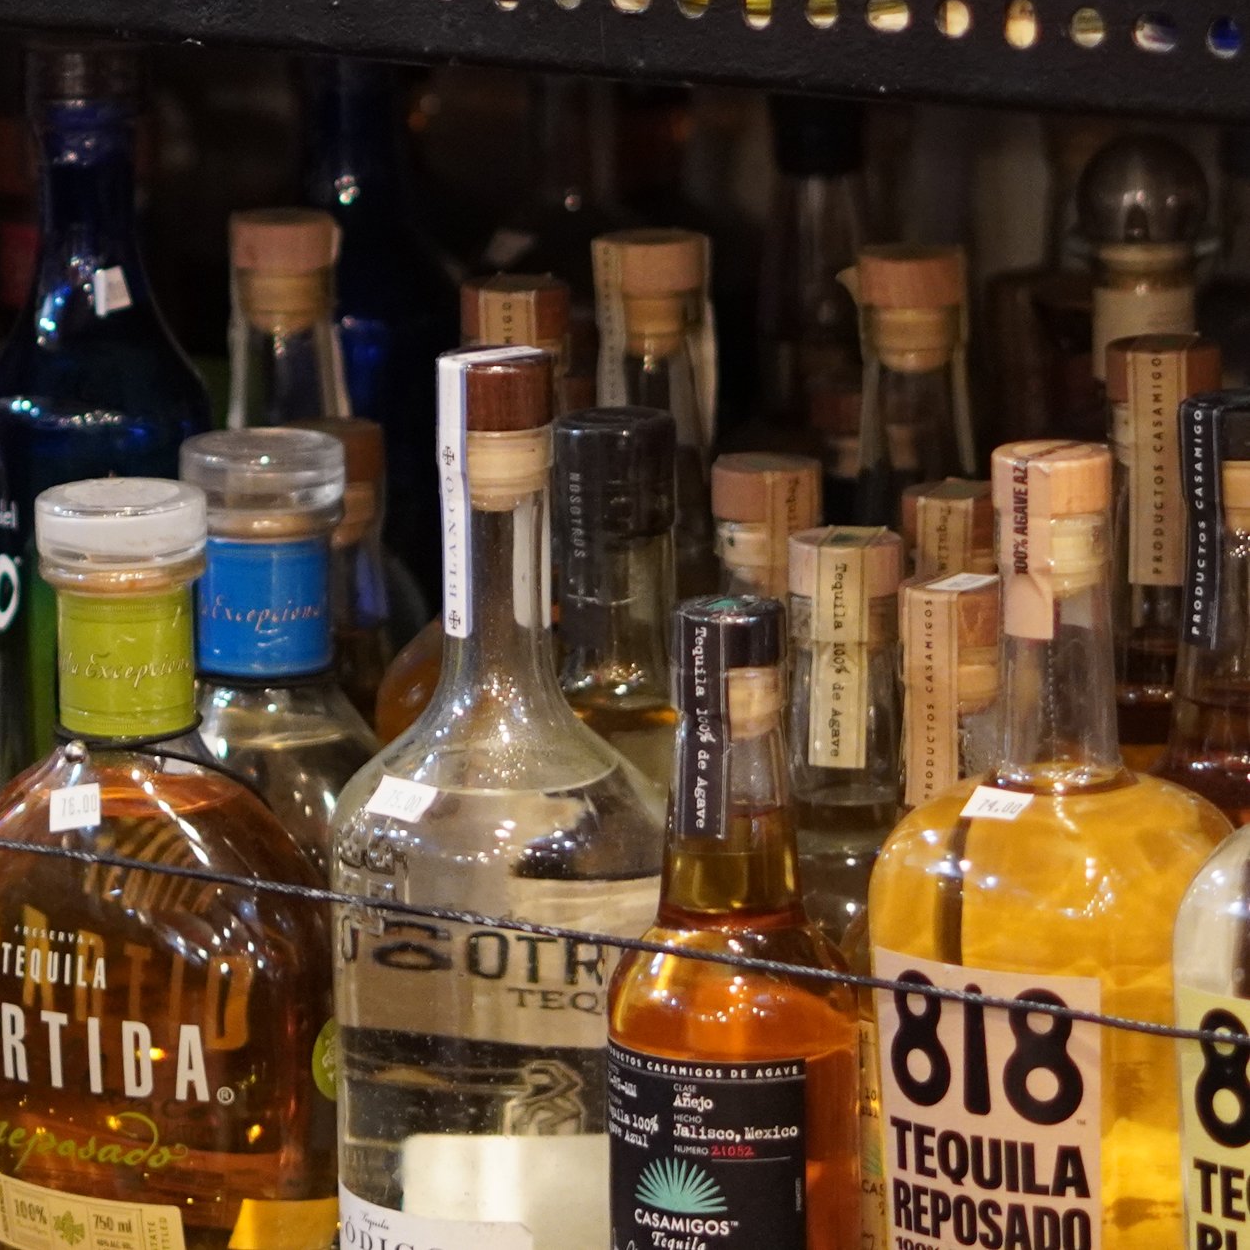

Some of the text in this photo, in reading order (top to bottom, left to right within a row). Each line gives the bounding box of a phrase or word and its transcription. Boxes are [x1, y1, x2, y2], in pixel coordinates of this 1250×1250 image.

[1013, 486, 1029, 576] 100% AGAVE
[1192, 521, 1206, 636] PRODUCTOS
[829, 563, 851, 758] Tequila 100% Agave
[924, 598, 935, 693] CASAMIGOS
[694, 626, 716, 830] Tequila 100% de Agave
[2, 942, 107, 990] TEQUILA
[891, 969, 1084, 1126] 818
[647, 1062, 722, 1078] CASAMIGOS
[730, 1069, 748, 1078] DE
[755, 1065, 798, 1078] AGAVE
[673, 1084, 697, 1093] CLASE
[673, 1093, 714, 1112] Añejo
[674, 1114, 702, 1124] HECHO
[632, 1113, 659, 1136] 100%
[673, 1124, 798, 1143] Jalisco, Mexico
[674, 1145, 709, 1155] NUMERO
[890, 1115, 1091, 1198] TEQUILA
[92, 1214, 114, 1231] 750
[634, 1208, 729, 1236] CASAMIGOS
[892, 1177, 1092, 1250] REPOSADO
